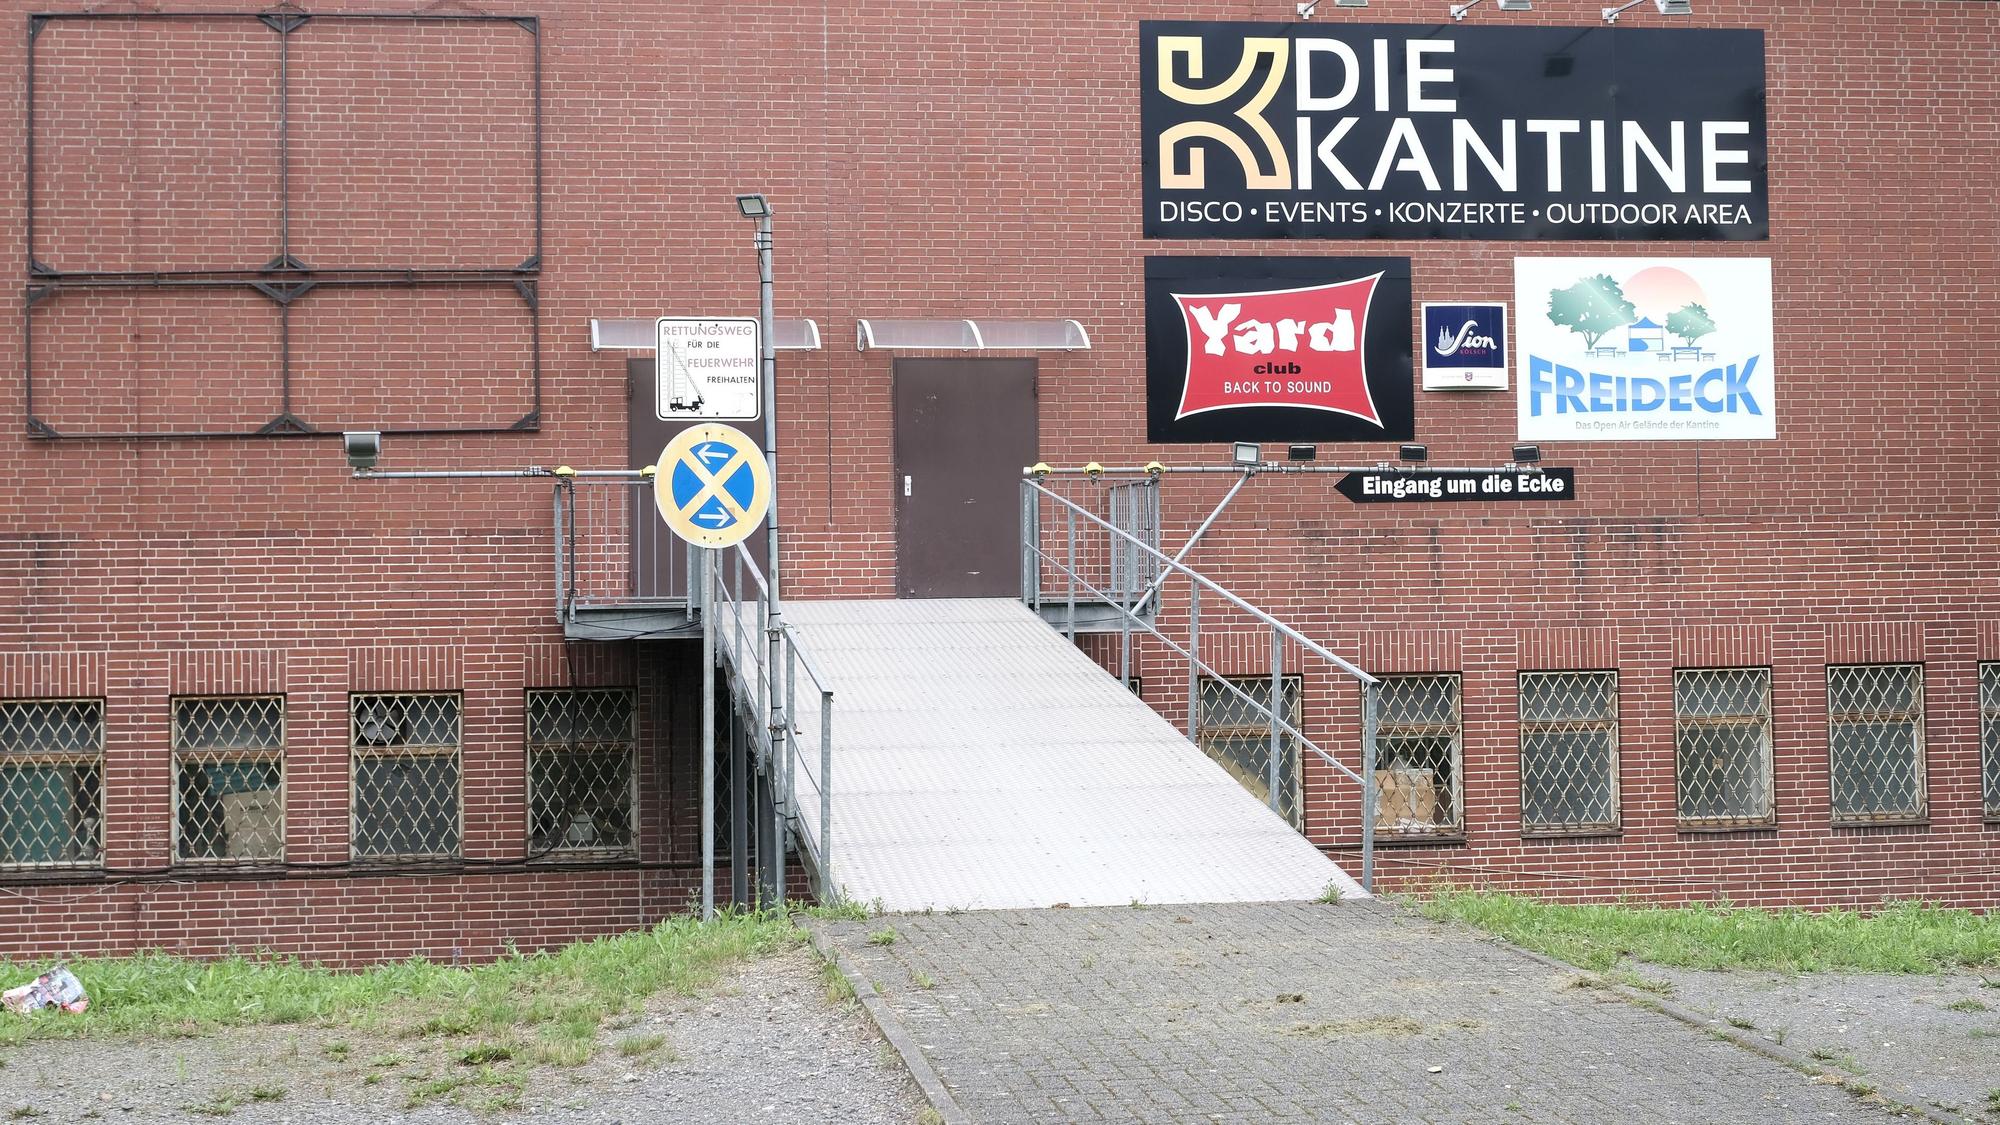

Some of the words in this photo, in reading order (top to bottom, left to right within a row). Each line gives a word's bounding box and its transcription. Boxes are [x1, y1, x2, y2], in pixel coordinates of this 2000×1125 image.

[1295, 37, 1457, 112] DIE
[1296, 116, 1752, 194] KANTINE
[1159, 200, 1243, 223] DISCO
[1265, 201, 1368, 224] EVENTS
[1389, 202, 1525, 224] KONZERTE
[1546, 203, 1678, 225] OUTDOOR
[1683, 204, 1753, 225] AREA
[663, 326, 753, 336] RETTUNGSWEG
[1188, 303, 1356, 357] Yard
[1434, 319, 1498, 357] Sion
[687, 338, 703, 349] FÜR
[706, 341, 720, 349] DIE
[687, 358, 755, 368] FEUERWEHR
[1253, 361, 1302, 375] club
[706, 376, 755, 384] FREIHALTEN
[1223, 381, 1260, 394] BACK
[1264, 381, 1282, 394] TO
[1286, 381, 1332, 394] SOUND
[1529, 354, 1763, 417] FREIDECK
[1575, 421, 1592, 430] Das
[1593, 421, 1617, 432] Open
[1618, 420, 1632, 430] Air
[1632, 419, 1668, 430] Gelände
[1669, 420, 1685, 430] der
[1686, 420, 1720, 430] Kantine
[1362, 475, 1443, 499] Eingang
[1447, 481, 1477, 494] um
[1481, 474, 1513, 494] die
[1517, 474, 1565, 493] Ecke
